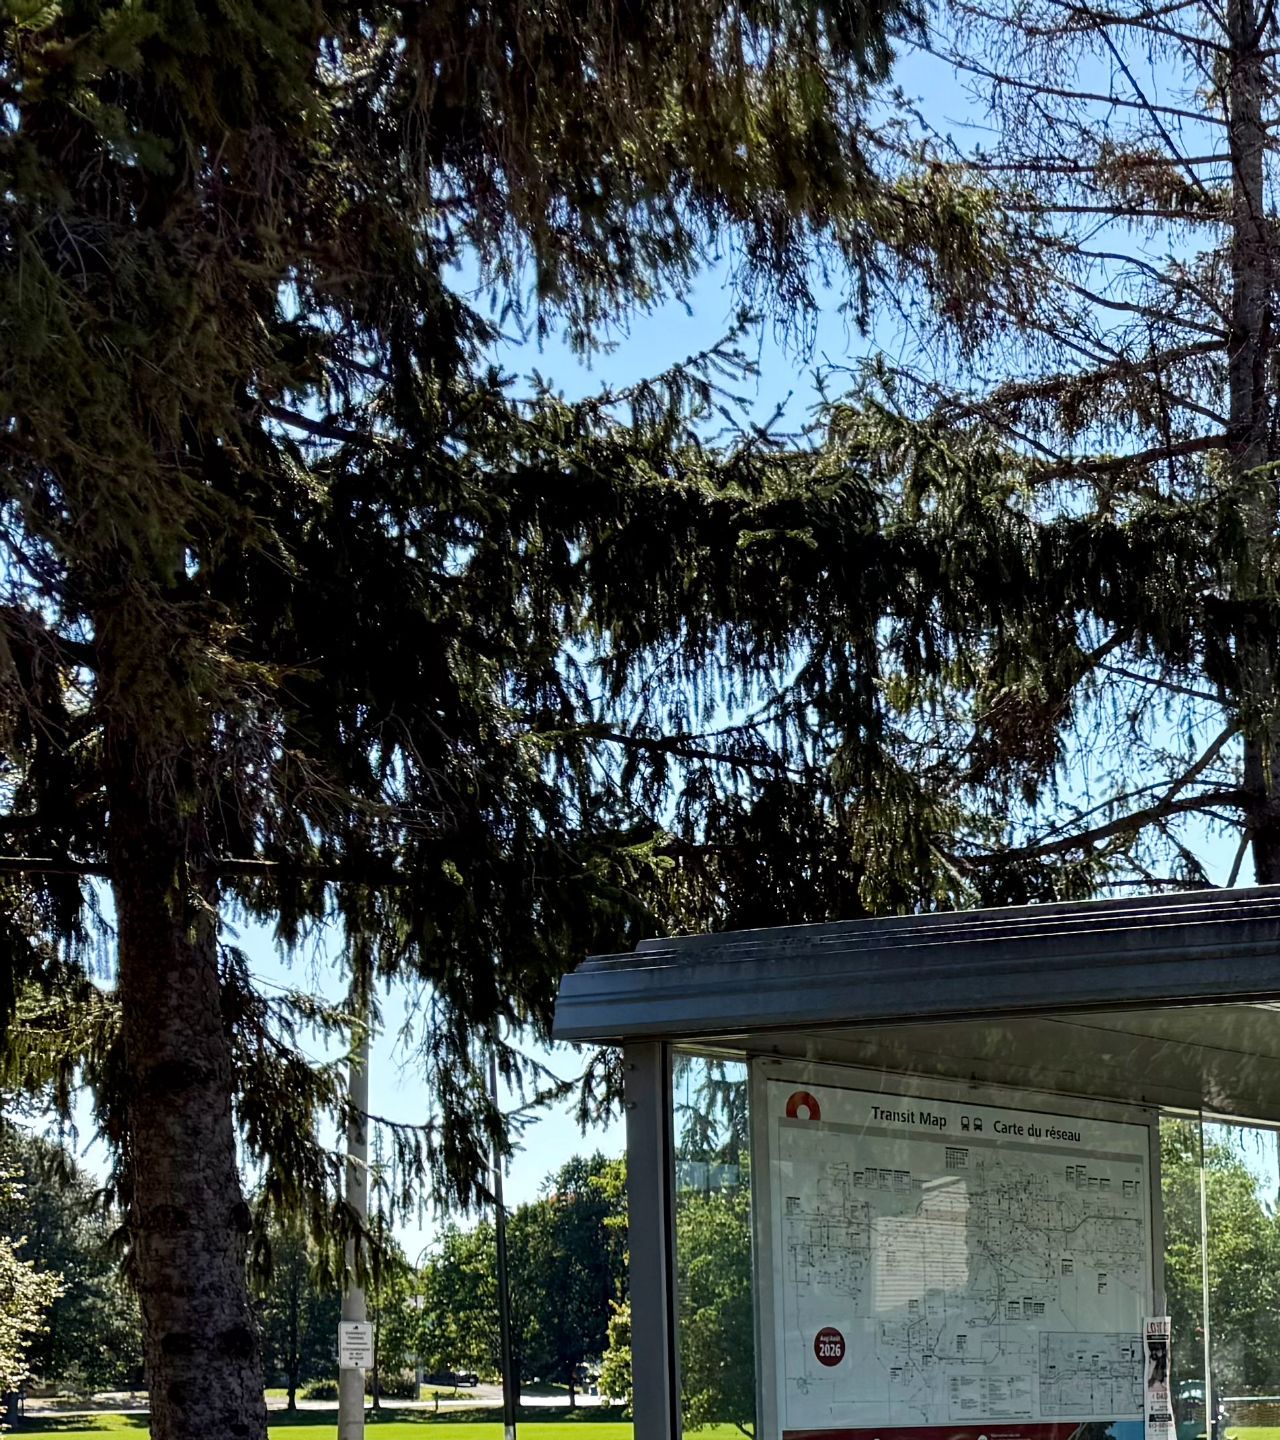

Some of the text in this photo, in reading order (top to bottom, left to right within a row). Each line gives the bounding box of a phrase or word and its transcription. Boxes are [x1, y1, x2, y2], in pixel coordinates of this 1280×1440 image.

[871, 1106, 947, 1130] Transit Map
[993, 1119, 1081, 1142] Carte du réseau
[819, 1343, 841, 1357] 2026
